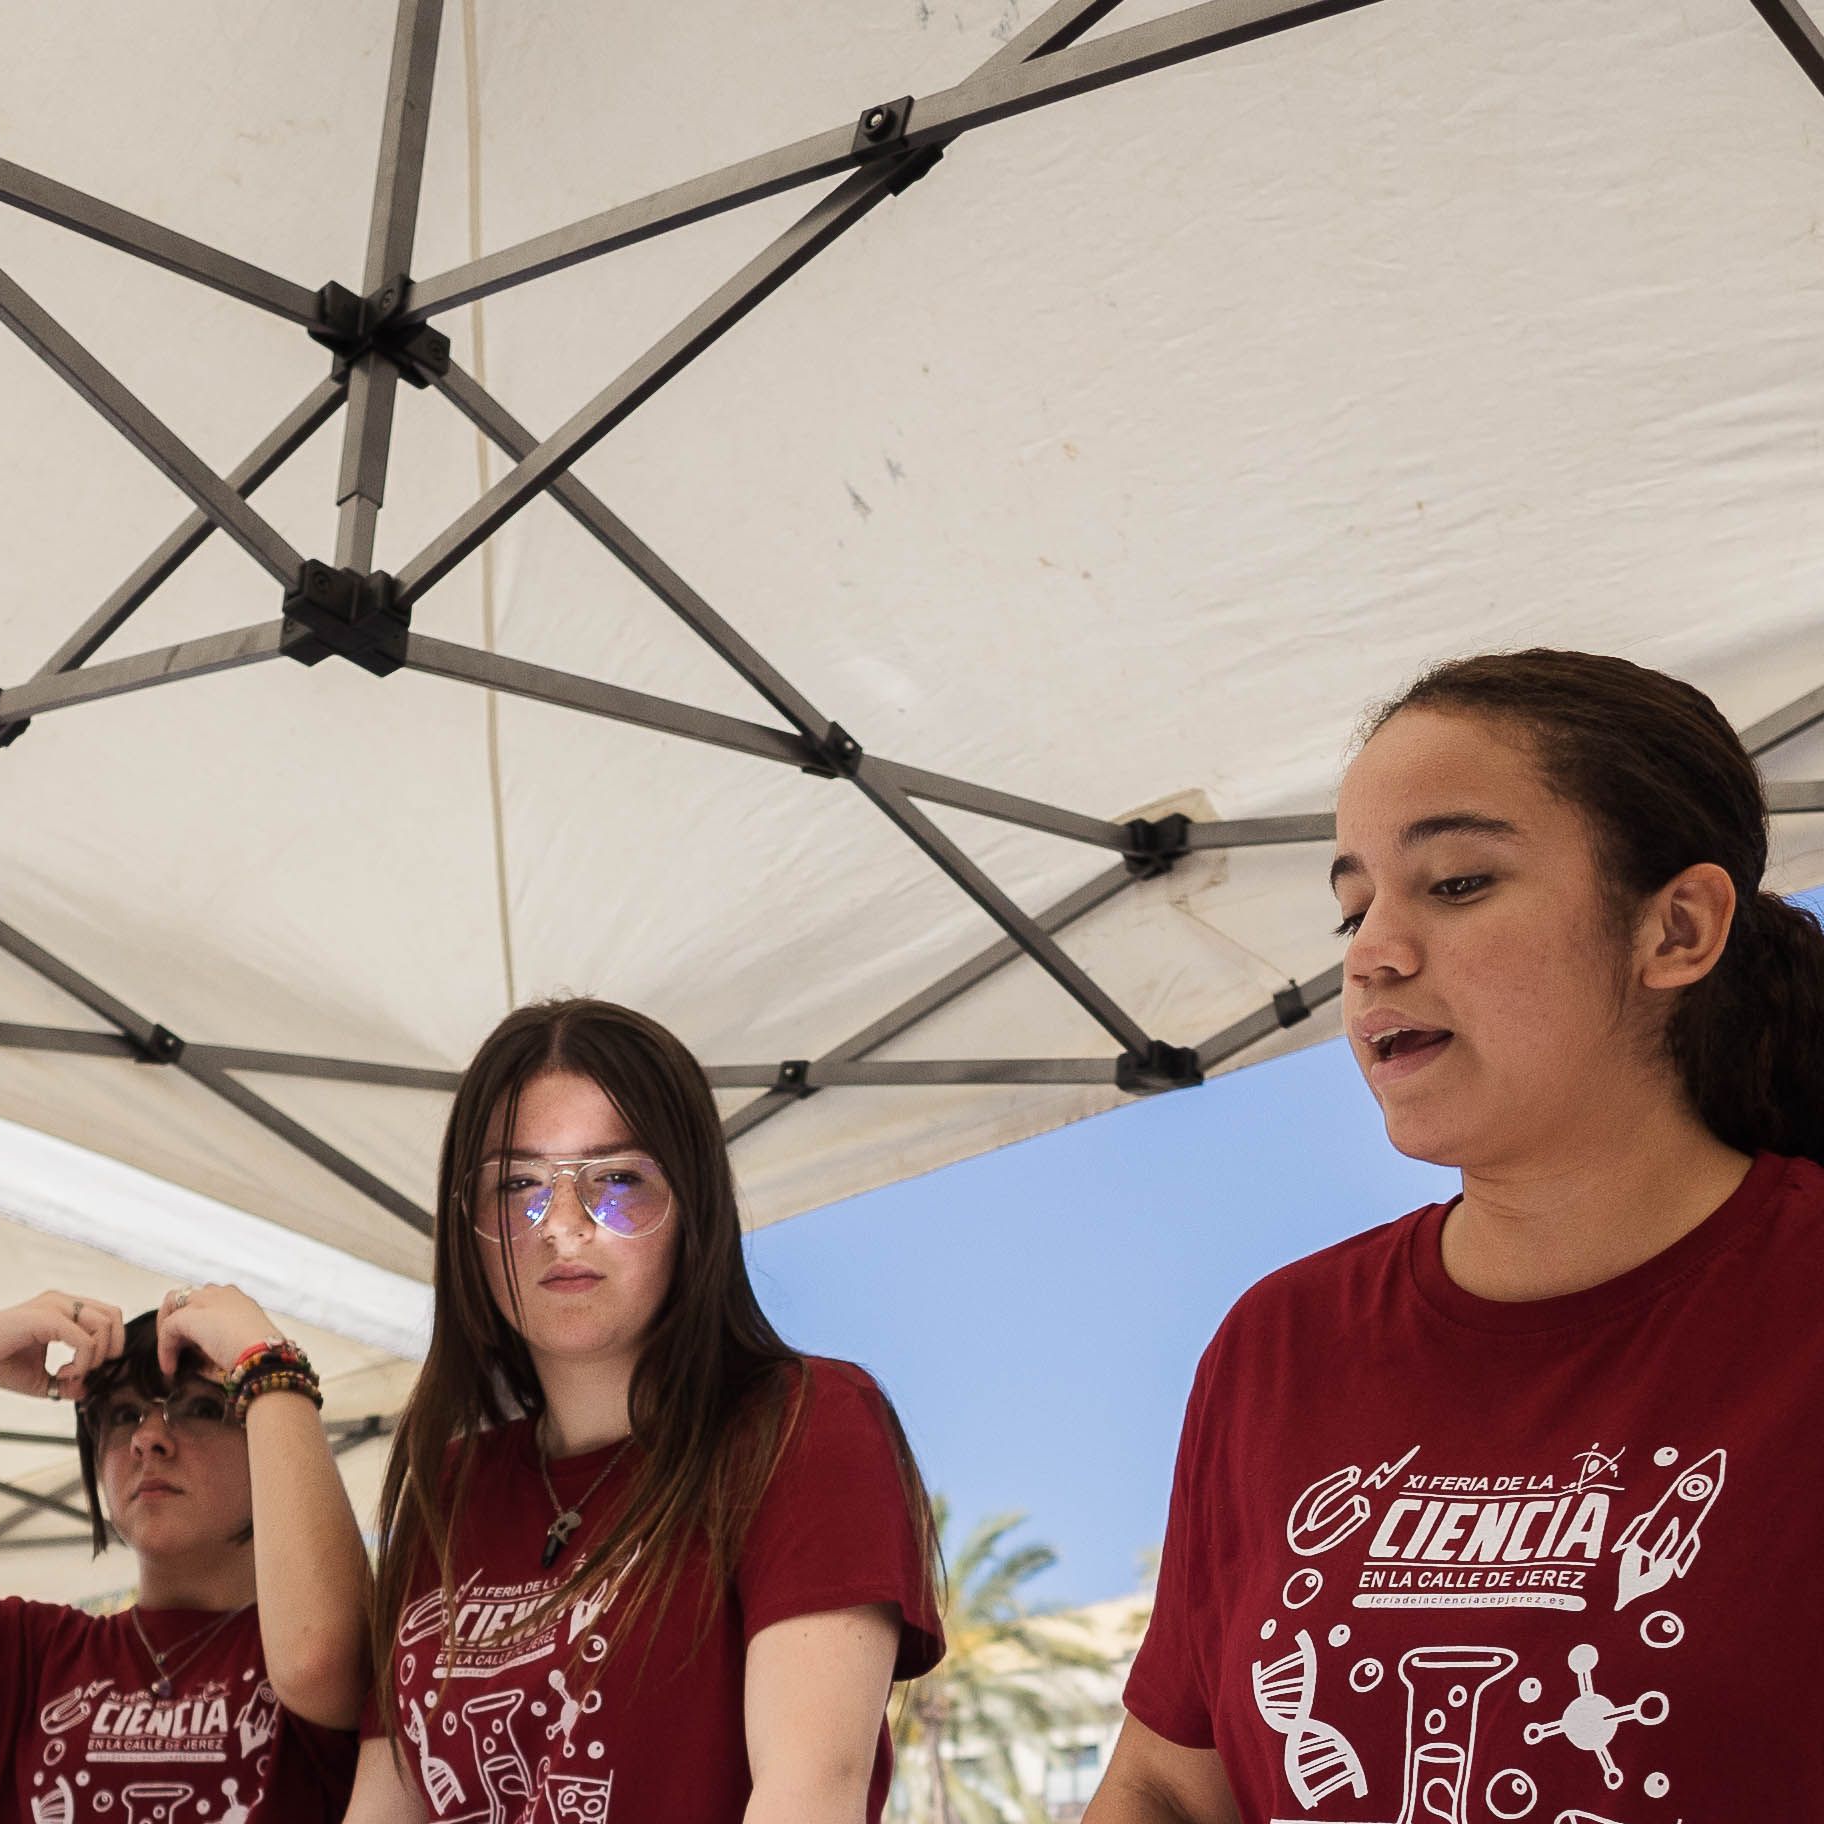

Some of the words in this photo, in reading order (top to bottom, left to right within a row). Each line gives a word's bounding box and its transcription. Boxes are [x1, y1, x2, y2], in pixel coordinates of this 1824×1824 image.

[1403, 1475, 1425, 1489] XI
[1428, 1476, 1489, 1491] FERIA
[1493, 1475, 1523, 1491] DE
[1526, 1474, 1554, 1490] LA
[1368, 1492, 1610, 1562] CIENCIA
[1359, 1571, 1383, 1588] EN
[1387, 1571, 1412, 1588] LA
[1417, 1571, 1483, 1588] CALLE
[1485, 1571, 1514, 1588] DE
[1516, 1570, 1585, 1589] JEREZ
[470, 1586, 482, 1598] XI
[485, 1585, 522, 1598] FERIA
[524, 1580, 542, 1592] DE
[456, 1654, 472, 1665] LA
[91, 1697, 228, 1738] CIENCIA
[88, 1739, 104, 1750] EN
[106, 1739, 121, 1750] LA
[124, 1739, 163, 1751] CALLE
[183, 1739, 223, 1750] JEREZ
